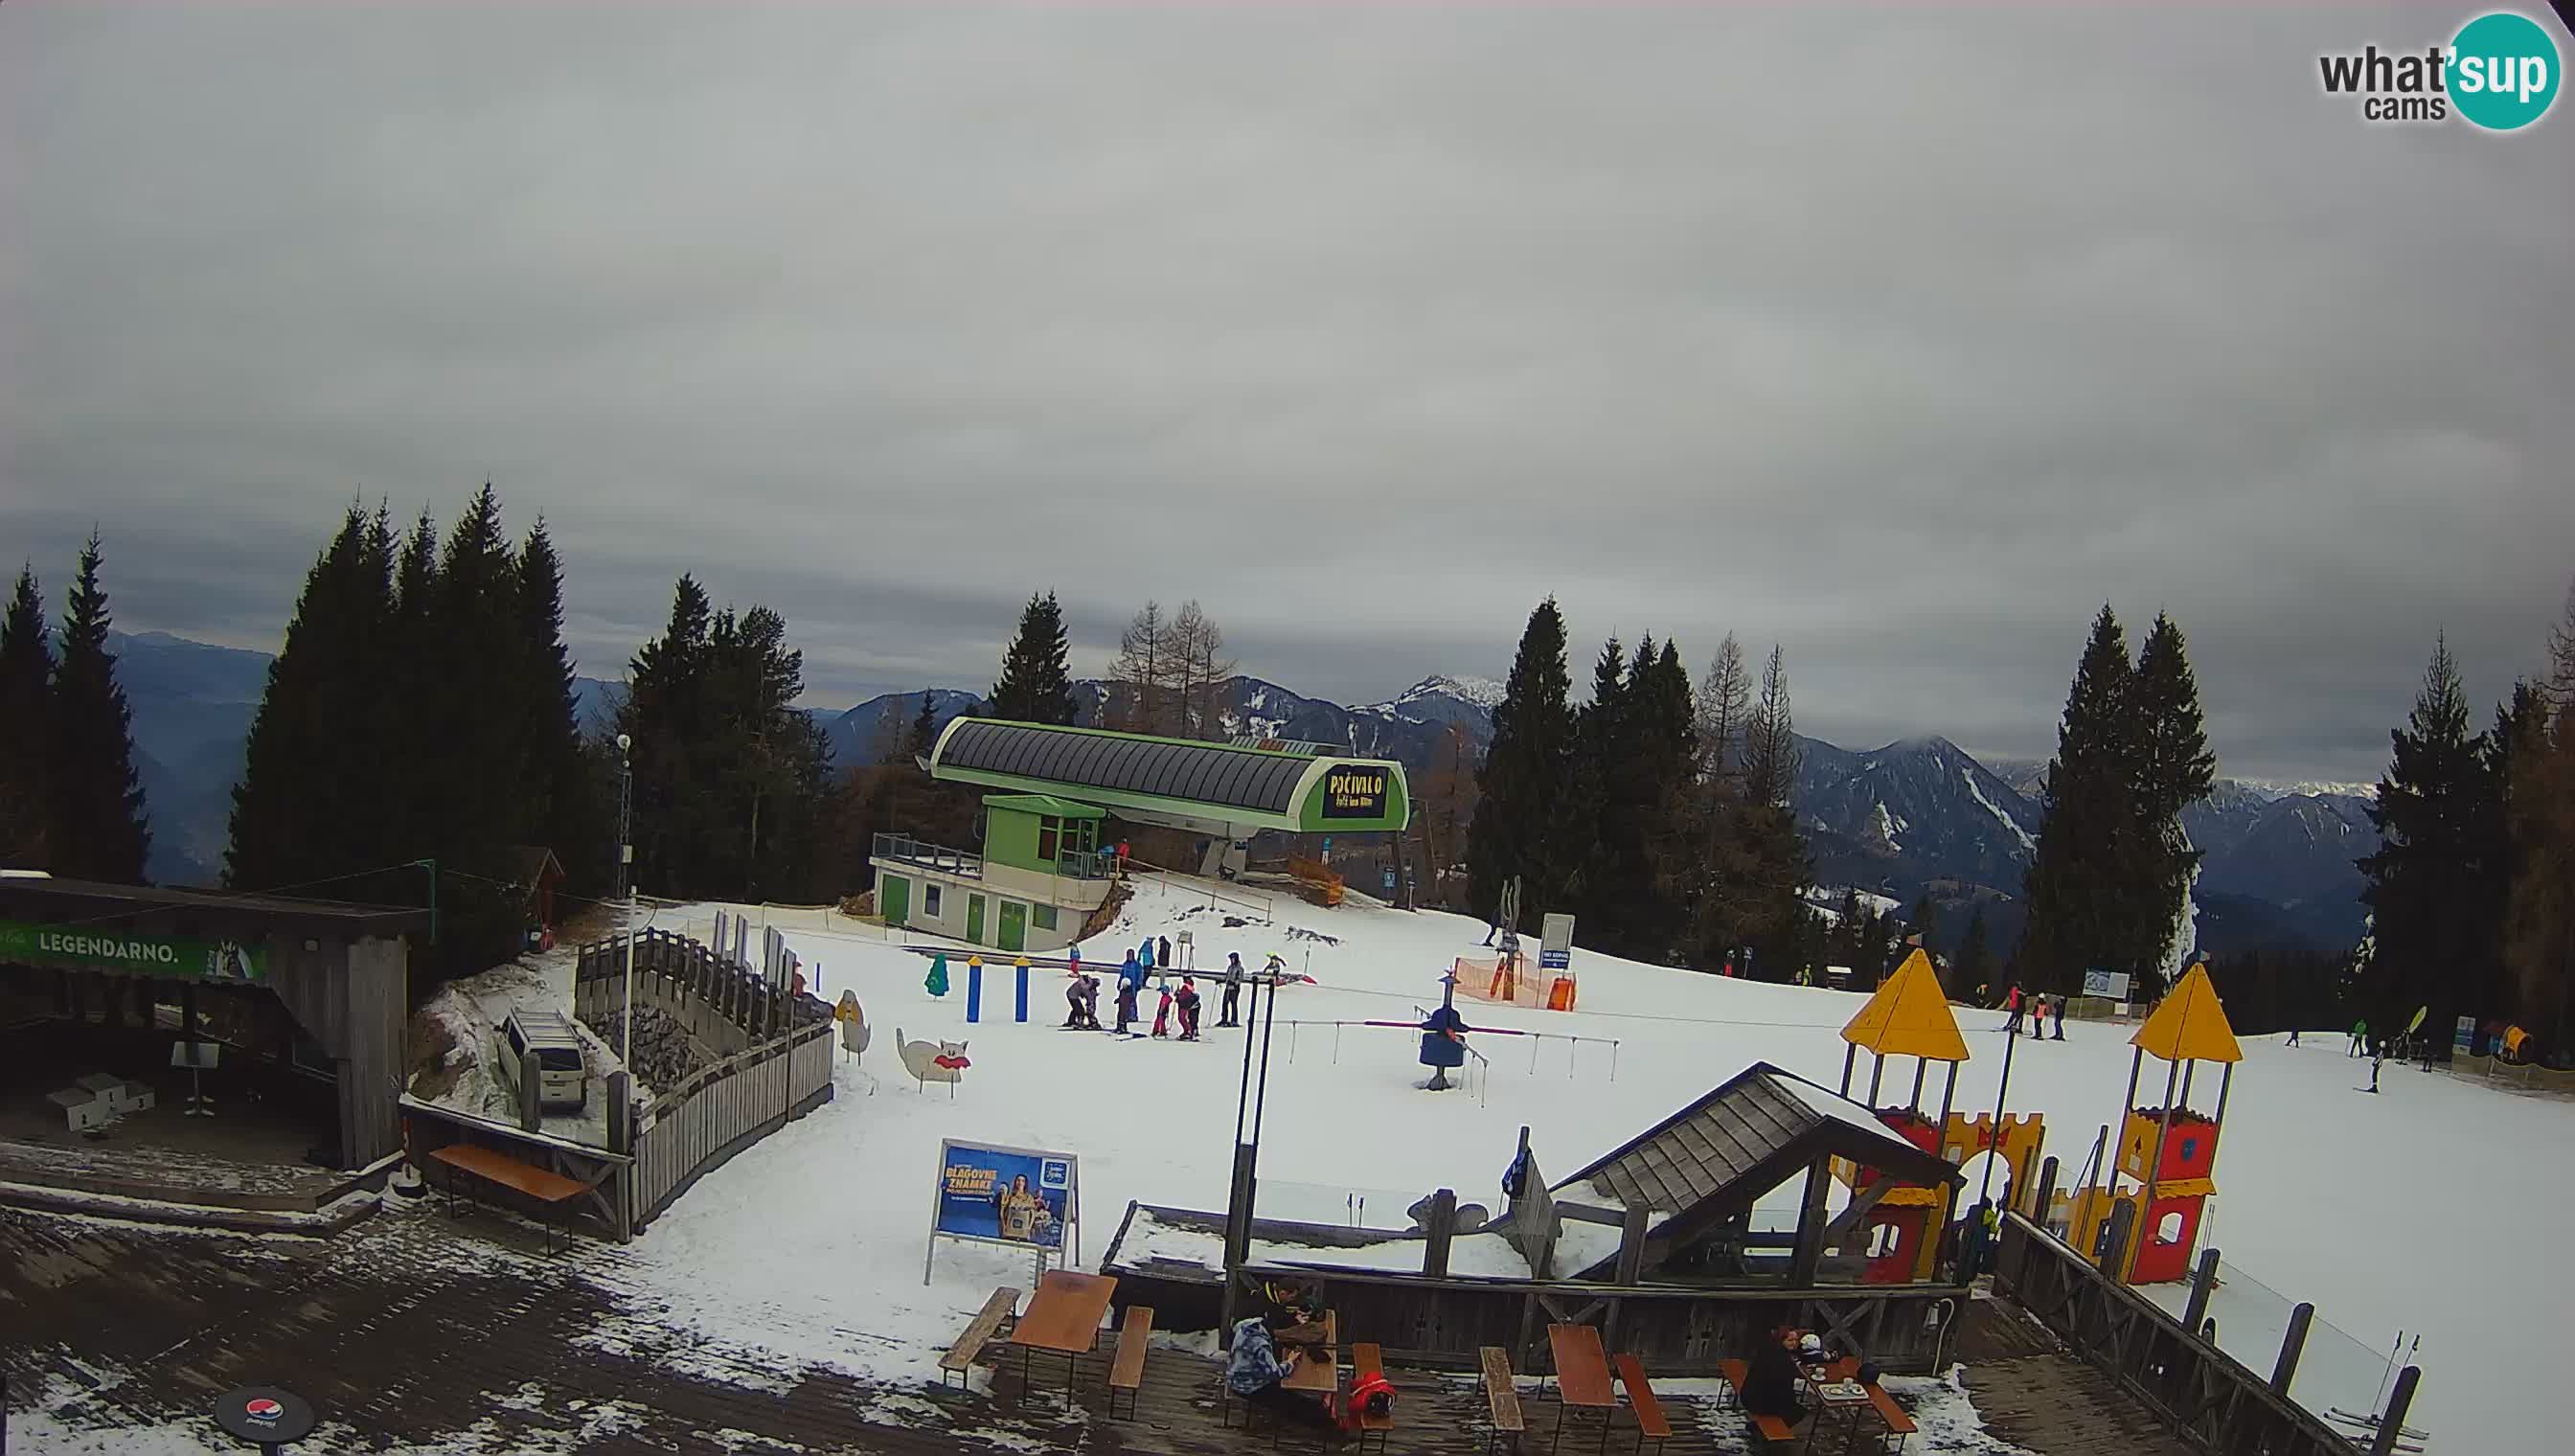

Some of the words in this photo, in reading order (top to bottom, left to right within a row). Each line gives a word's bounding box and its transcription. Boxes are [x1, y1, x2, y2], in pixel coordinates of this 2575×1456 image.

[39, 932, 179, 964] LEGENDARNO.
[946, 1168, 996, 1180] BLAGOVNE
[949, 1178, 992, 1190] ZNAMKE
